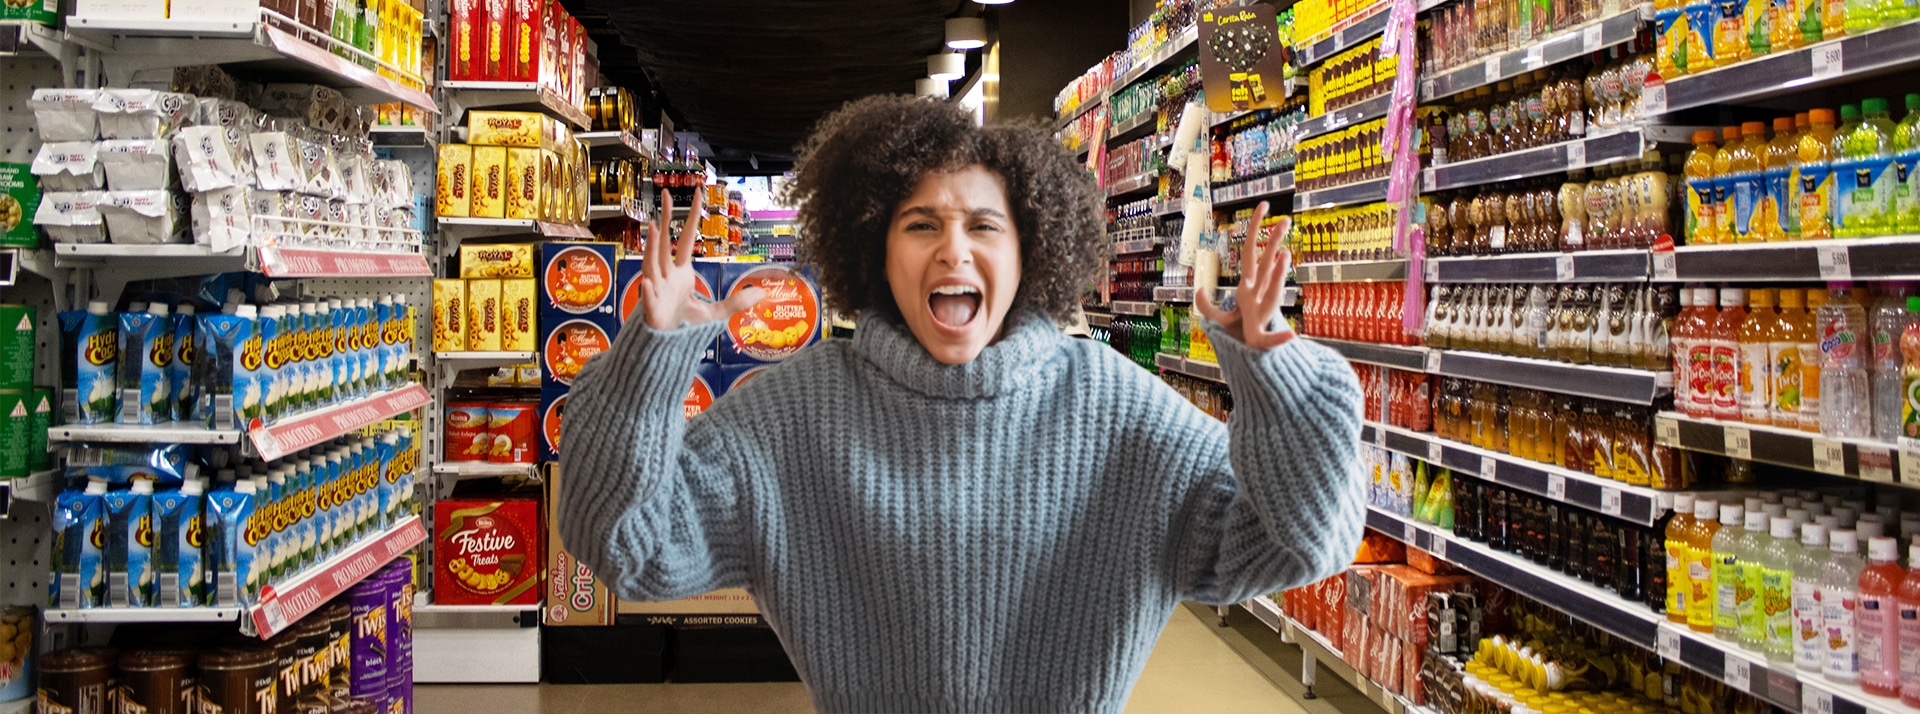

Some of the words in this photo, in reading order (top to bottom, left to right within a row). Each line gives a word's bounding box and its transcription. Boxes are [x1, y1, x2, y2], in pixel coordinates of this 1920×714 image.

[488, 118, 521, 129] ROYAL
[455, 164, 465, 198] ROYAL
[490, 165, 500, 199] ROYAL
[525, 166, 535, 200] ROYAL
[334, 257, 378, 273] PROMOTION
[479, 251, 511, 261] ROYAL
[450, 298, 460, 332] ROYAL
[485, 297, 495, 332] ROYAL
[518, 297, 528, 332] ROYAL
[88, 330, 116, 349] Hydr
[332, 404, 379, 430] PROMOTION
[386, 389, 425, 412] PROMOTION
[332, 550, 377, 588] PROMOTION
[385, 523, 422, 556] PROMOTION
[451, 528, 515, 555] Festive
[471, 554, 498, 567] Treats
[571, 560, 594, 611] Cris
[354, 612, 386, 639] Twis
[683, 616, 723, 625] ASSORTED
[724, 616, 758, 625] COOKIES
